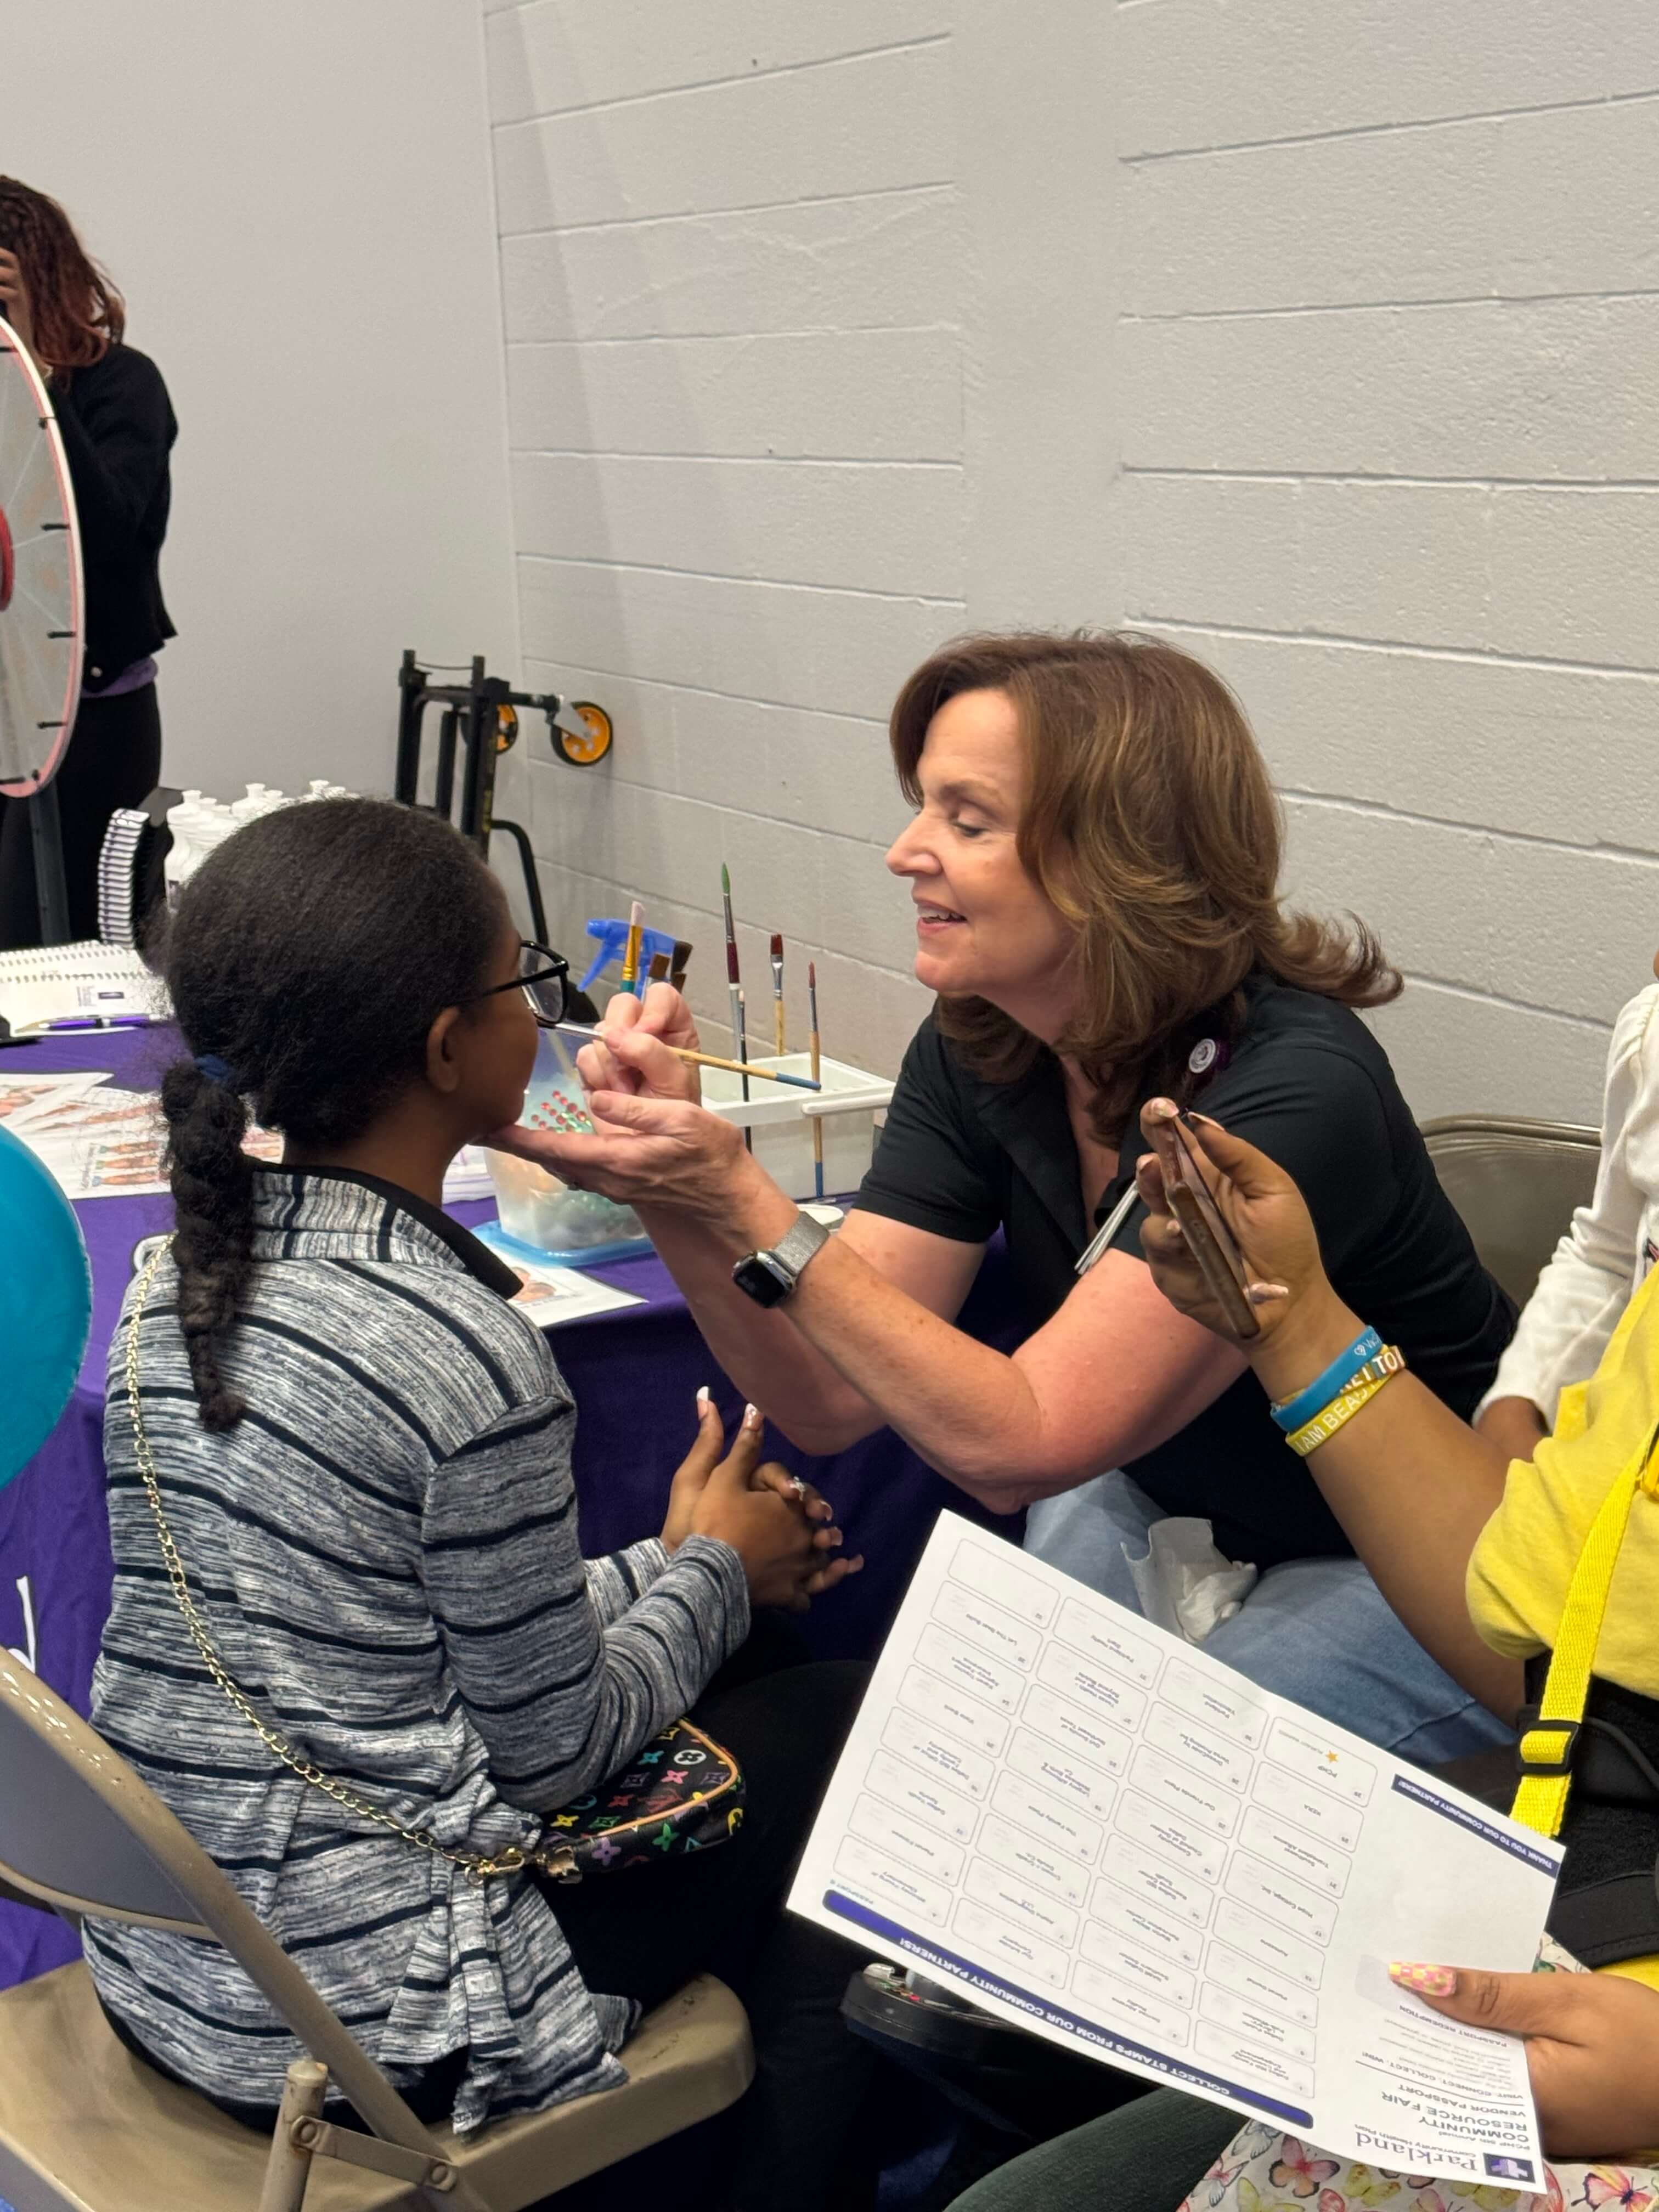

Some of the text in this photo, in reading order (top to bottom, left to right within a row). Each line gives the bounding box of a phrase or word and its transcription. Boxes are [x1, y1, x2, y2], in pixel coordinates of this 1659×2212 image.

[1304, 1424, 1326, 1449] AM
[995, 1629, 1008, 1640] The
[1006, 1636, 1018, 1646] Let
[1108, 1644, 1135, 1663] Parkland
[1074, 1675, 1087, 1686] and
[1077, 1683, 1115, 1708] Texas Health
[1097, 1681, 1120, 1699] Beyond
[1058, 1715, 1077, 1730] Texas
[928, 1740, 962, 1764] Community
[1182, 1739, 1192, 1748] by
[1316, 1763, 1338, 1778] PCHP
[917, 1790, 939, 1805] Sports
[1180, 1787, 1204, 1805] Friends
[925, 1800, 946, 1816] Dallas
[1203, 1801, 1216, 1812] Our
[1438, 1801, 1483, 1830] COMMUNITY
[1045, 1814, 1065, 1830] Family
[1064, 1826, 1077, 1837] The
[1481, 1825, 1500, 1839] OUR
[1498, 1835, 1511, 1846] TO
[913, 1842, 935, 1857] Planet
[1156, 1832, 1192, 1857] Community
[1178, 1839, 1203, 1857] Council
[1510, 1841, 1528, 1855] YOU
[1297, 1847, 1330, 1869] Transplant
[1526, 1850, 1554, 1869] THANK
[836, 1882, 874, 1905] PASSPORT
[1296, 1905, 1314, 1918] Hope
[1245, 1976, 1288, 2002] Planet Dental
[898, 1936, 1231, 2096] COLLECT STAMPS FROM OUR COMMUNITY PARTNERS!
[1398, 2004, 1455, 2032] REDEMPTION
[1262, 2029, 1284, 2042] Dallas
[1457, 2029, 1506, 2047] PASSPORT
[1396, 2083, 1525, 2117] VENDOR PASSPORT
[1381, 2090, 1526, 2131] RESOURCE FAIR
[1418, 2115, 1528, 2143] COMMUNITY
[1438, 2131, 1476, 2141] Annual
[1355, 2123, 1476, 2158] Community Health Plan
[1499, 2141, 1530, 2151] PCHP
[1355, 2131, 1476, 2171] Parkland
